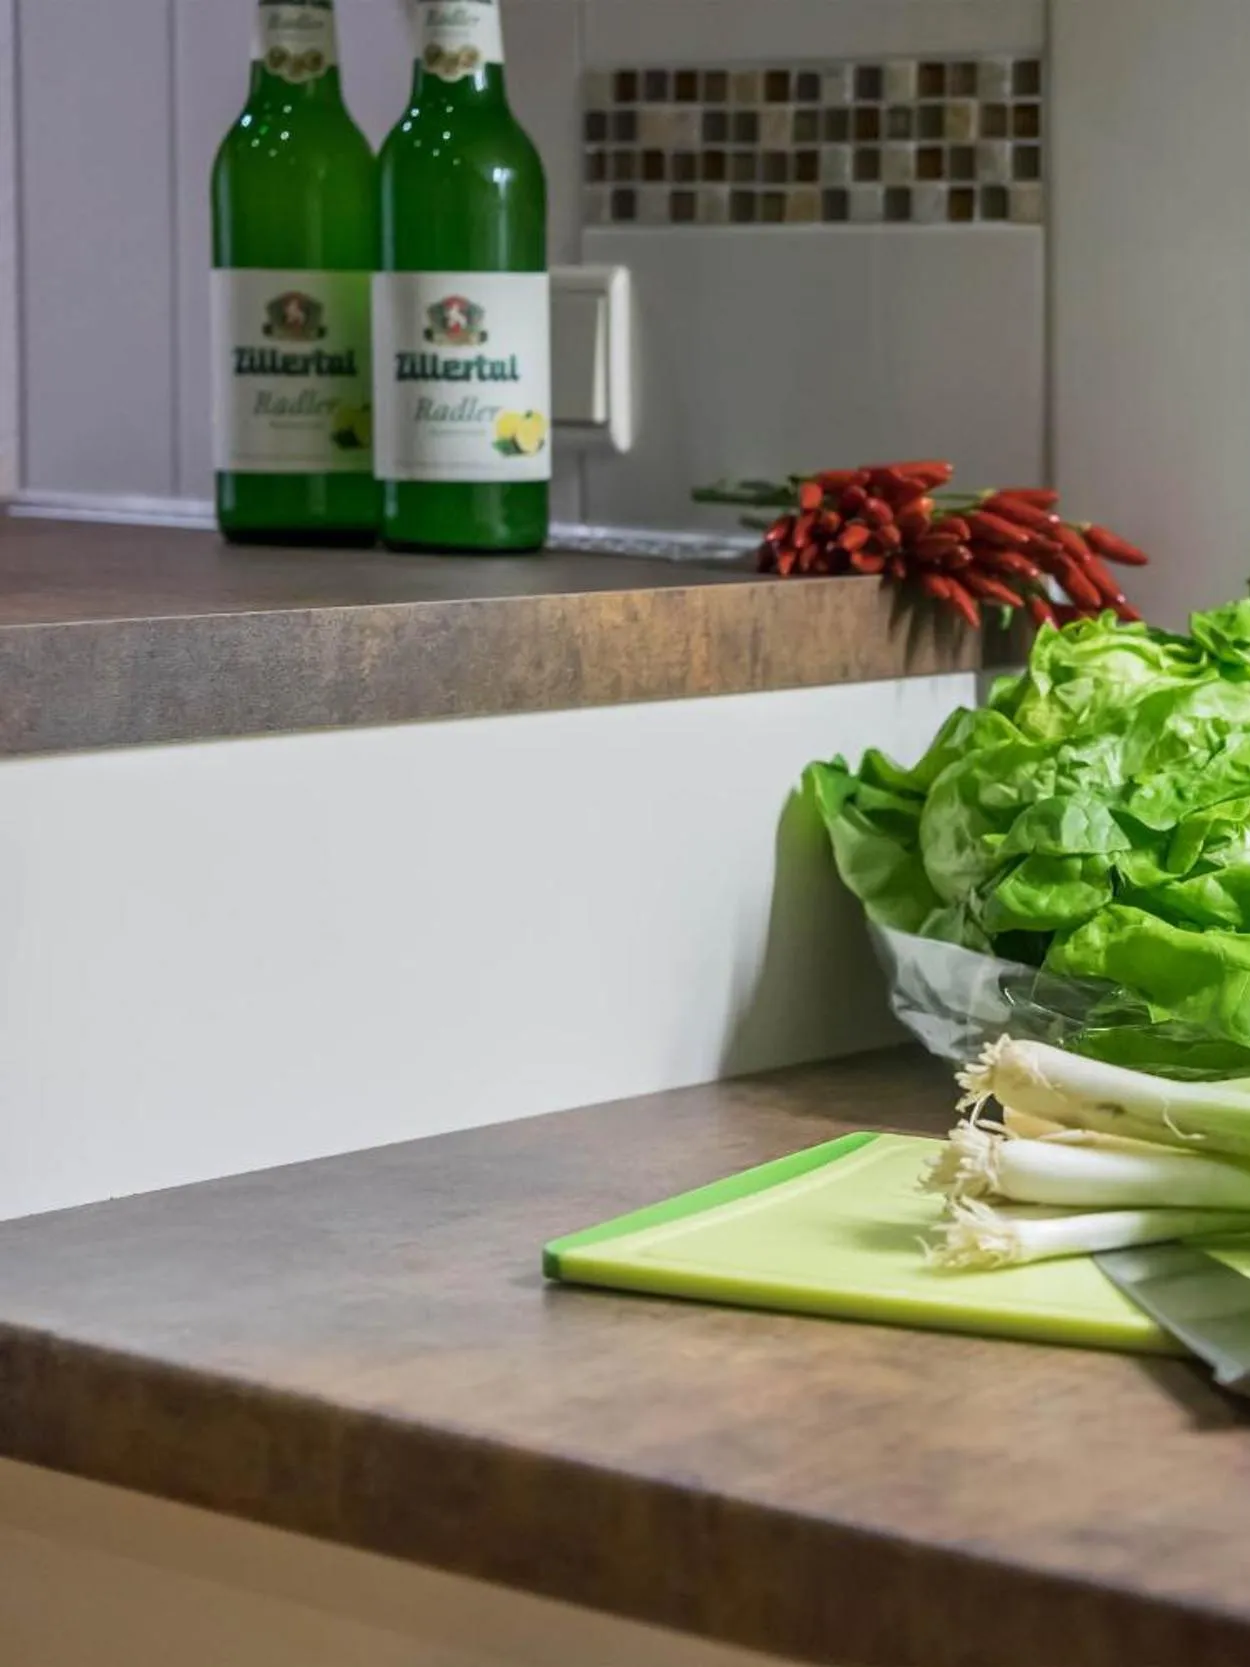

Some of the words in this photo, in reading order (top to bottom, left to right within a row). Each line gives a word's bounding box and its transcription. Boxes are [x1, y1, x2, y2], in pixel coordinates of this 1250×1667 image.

[234, 347, 358, 376] Zillertal
[395, 352, 520, 382] Zillertal
[253, 389, 340, 416] Radler
[414, 396, 504, 422] Radler
